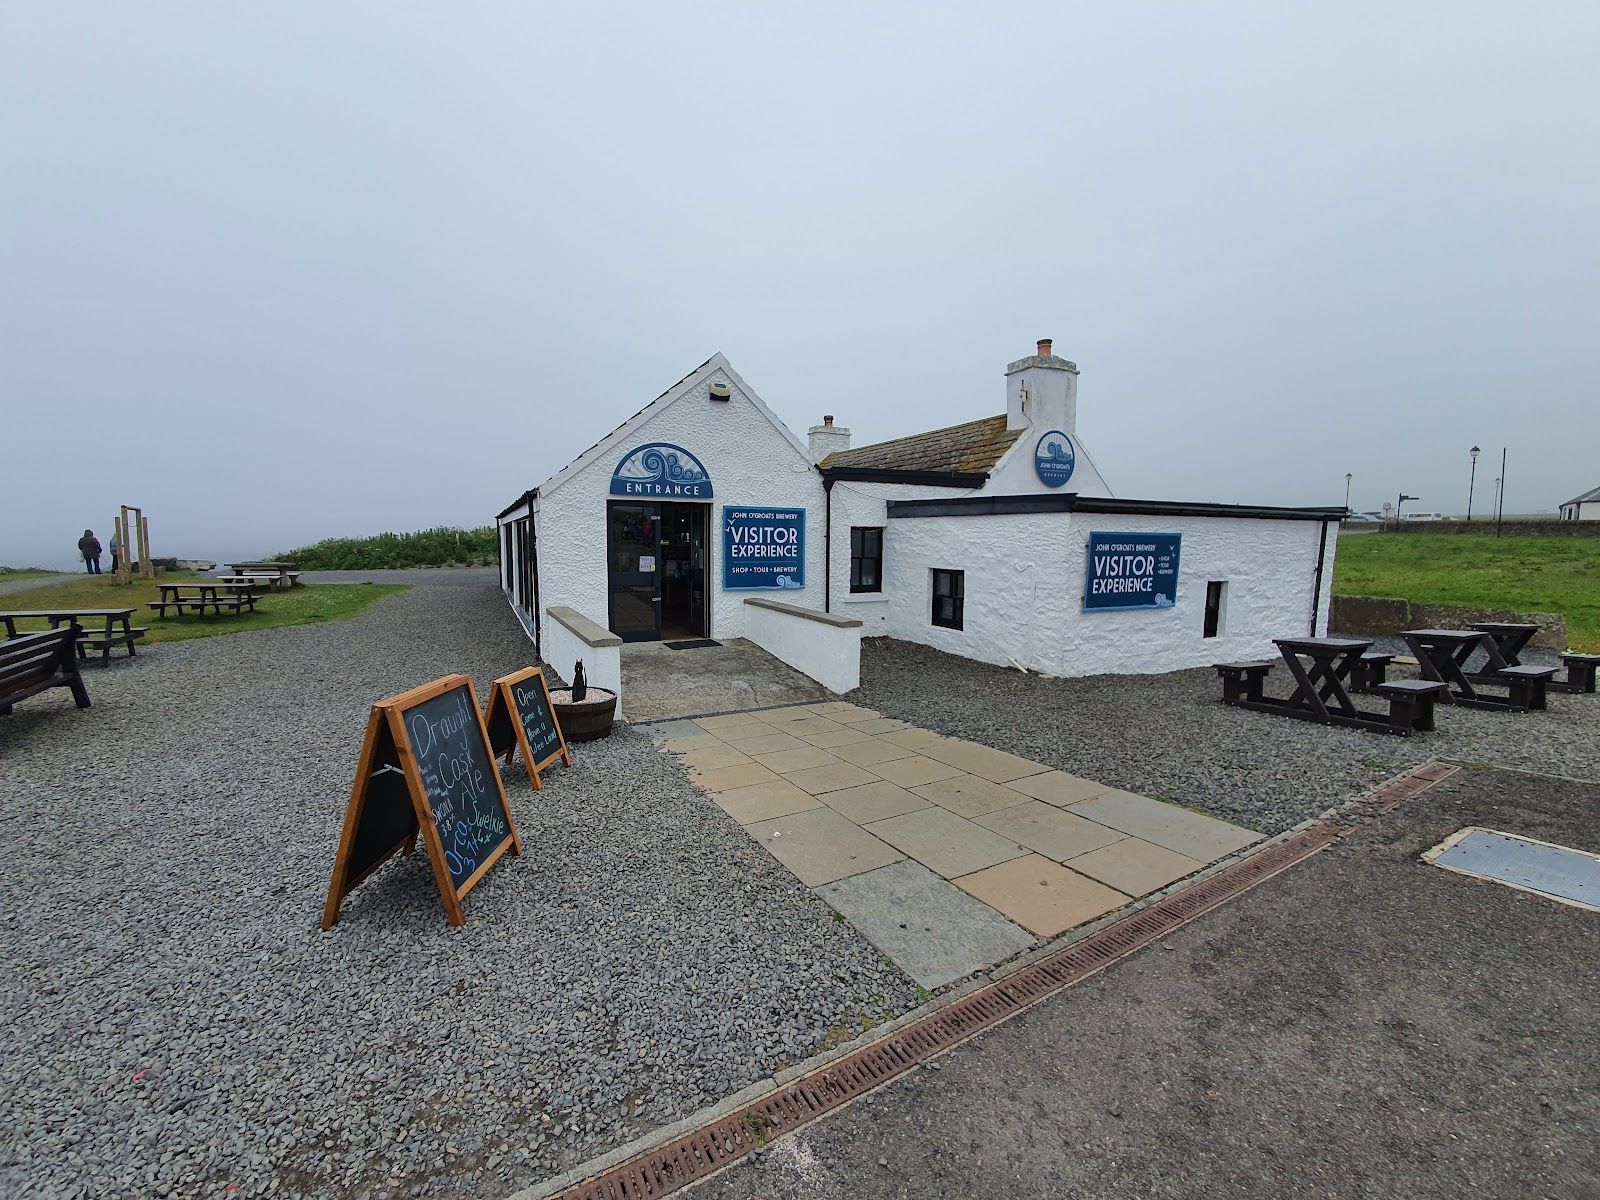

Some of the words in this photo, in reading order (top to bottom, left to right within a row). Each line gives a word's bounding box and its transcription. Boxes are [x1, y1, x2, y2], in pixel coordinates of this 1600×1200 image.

[626, 483, 699, 495] ENTRANCE
[731, 526, 798, 544] VISITOR
[731, 544, 798, 557] EXPERIENCE
[1095, 543, 1110, 551] JOHN
[1110, 543, 1135, 552] O'GROATS
[1135, 543, 1157, 552] BREWERY
[1094, 555, 1155, 577] VISITOR
[1092, 577, 1154, 594] EXPERIENCE
[516, 687, 537, 707] Open
[412, 691, 472, 759] Draught
[438, 749, 475, 789] Cask
[461, 769, 486, 810] Ale
[444, 820, 468, 875] Orca
